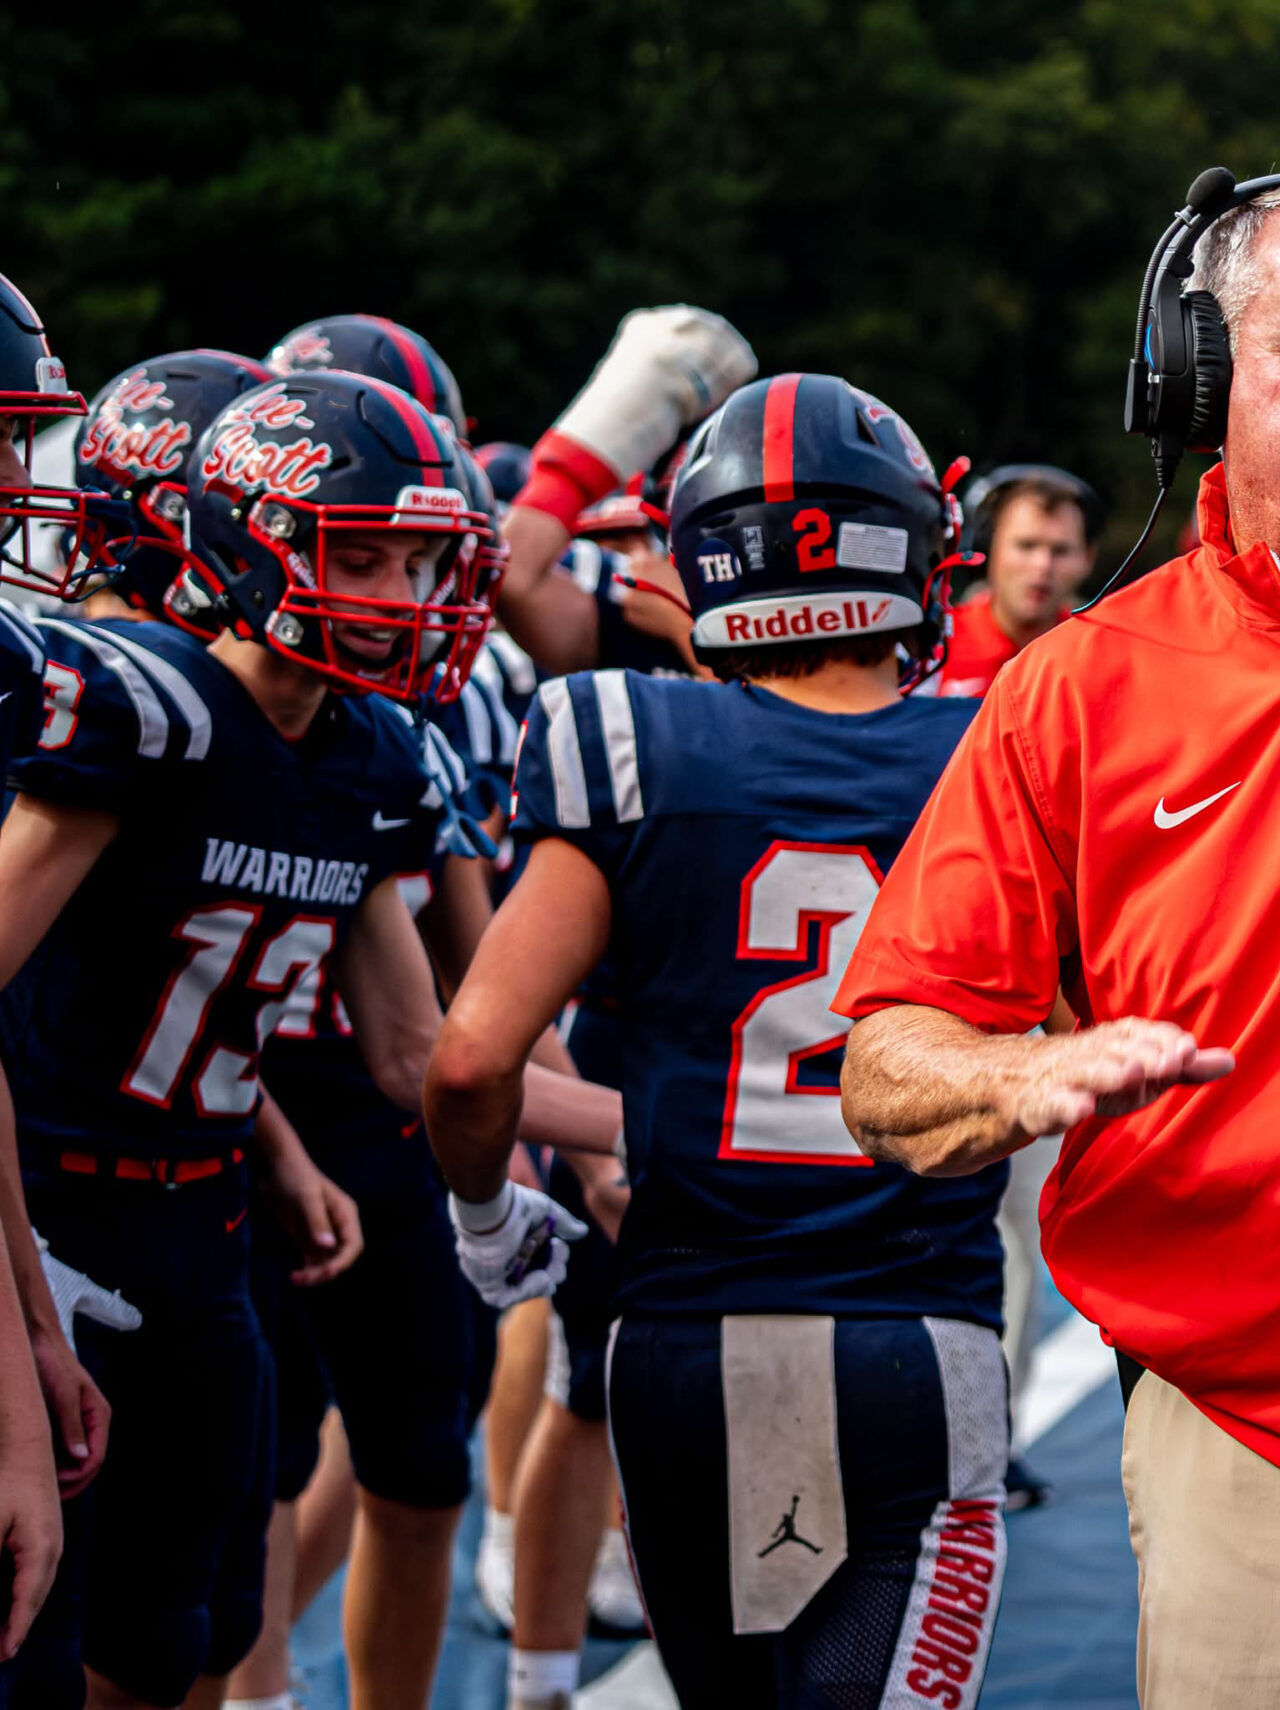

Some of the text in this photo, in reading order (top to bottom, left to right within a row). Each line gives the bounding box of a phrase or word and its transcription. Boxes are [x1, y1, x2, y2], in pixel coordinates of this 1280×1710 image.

[80, 408, 191, 476] Scott
[202, 422, 332, 498] Scott
[697, 553, 735, 583] TH
[792, 507, 836, 573] 2
[725, 600, 869, 642] Riddell
[201, 837, 369, 906] WARRIORS
[717, 840, 885, 1166] 2
[905, 1499, 999, 1710] WARRIORS
